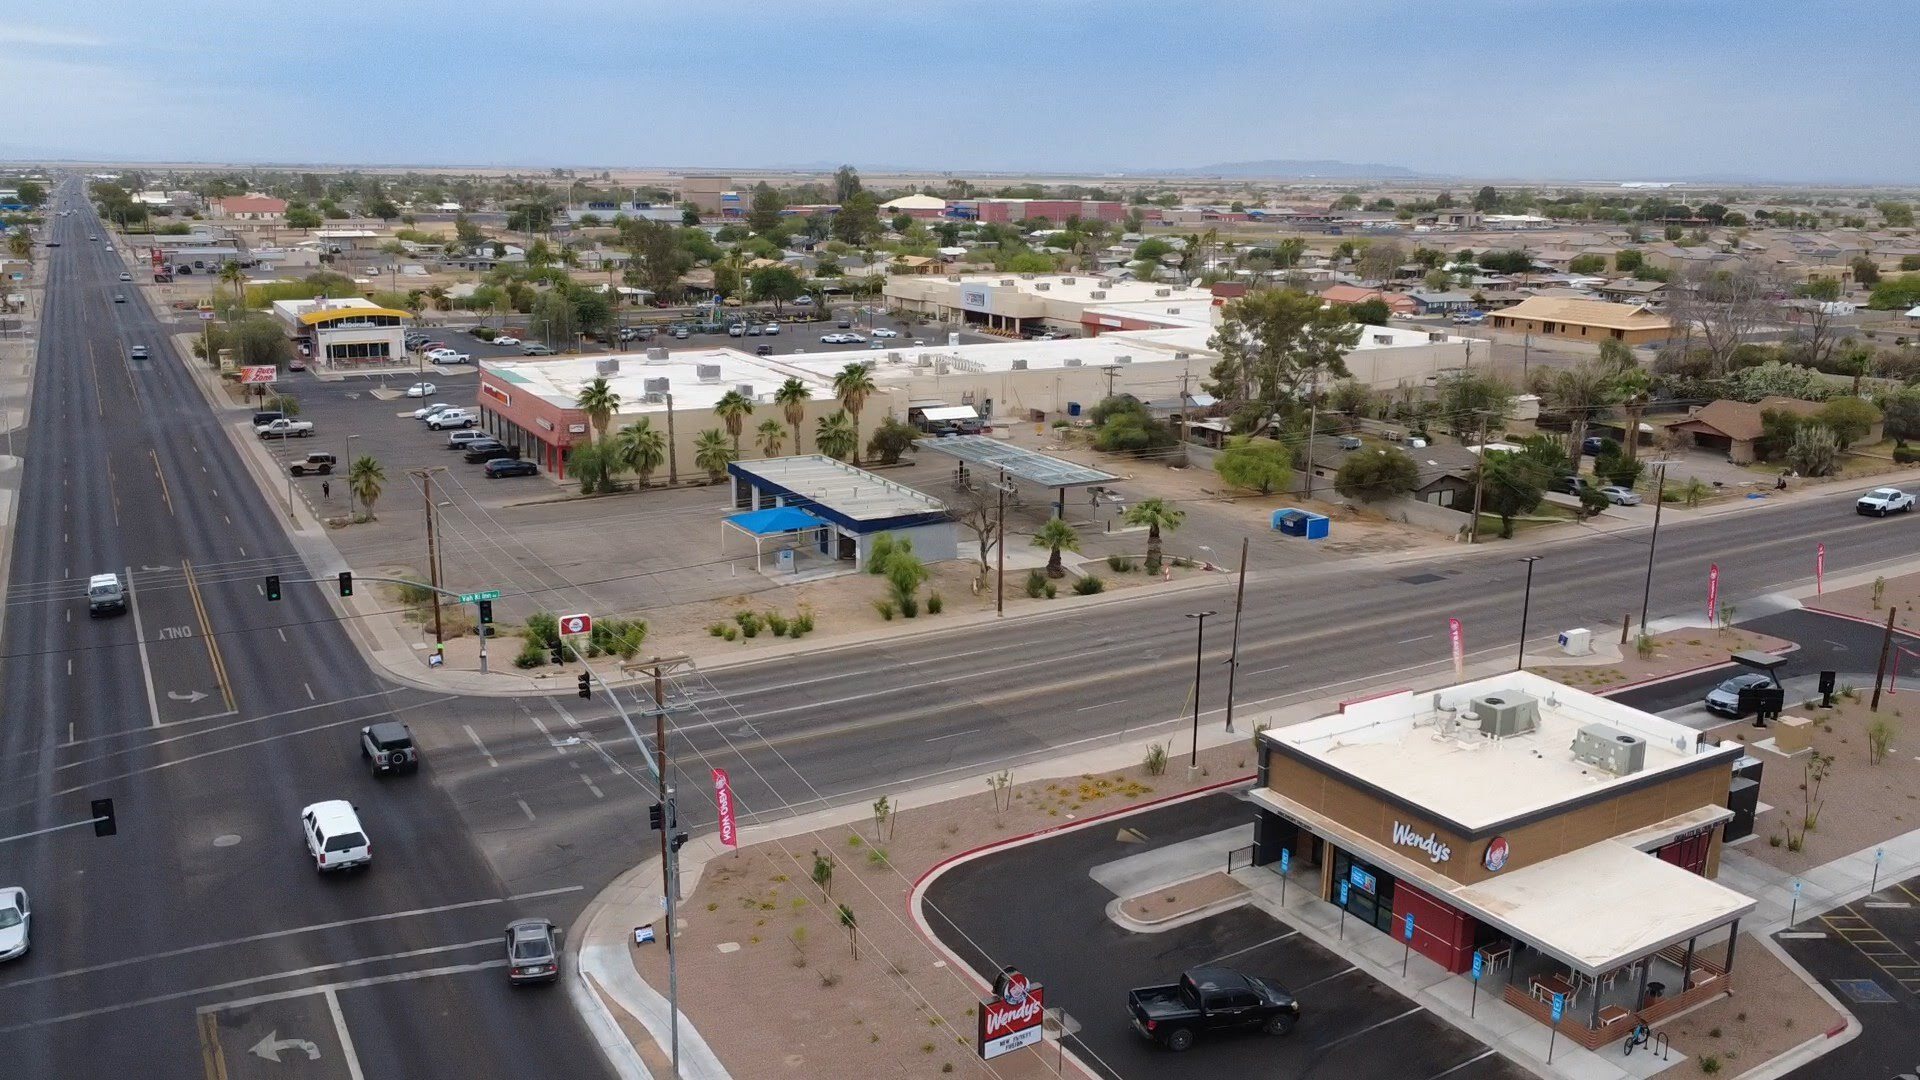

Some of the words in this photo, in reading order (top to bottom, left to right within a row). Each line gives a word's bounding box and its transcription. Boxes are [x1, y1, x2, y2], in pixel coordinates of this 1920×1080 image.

[255, 367, 275, 375] Auto
[252, 374, 274, 382] Zone
[159, 625, 192, 640] ONLY
[1392, 820, 1451, 863] Wendy's
